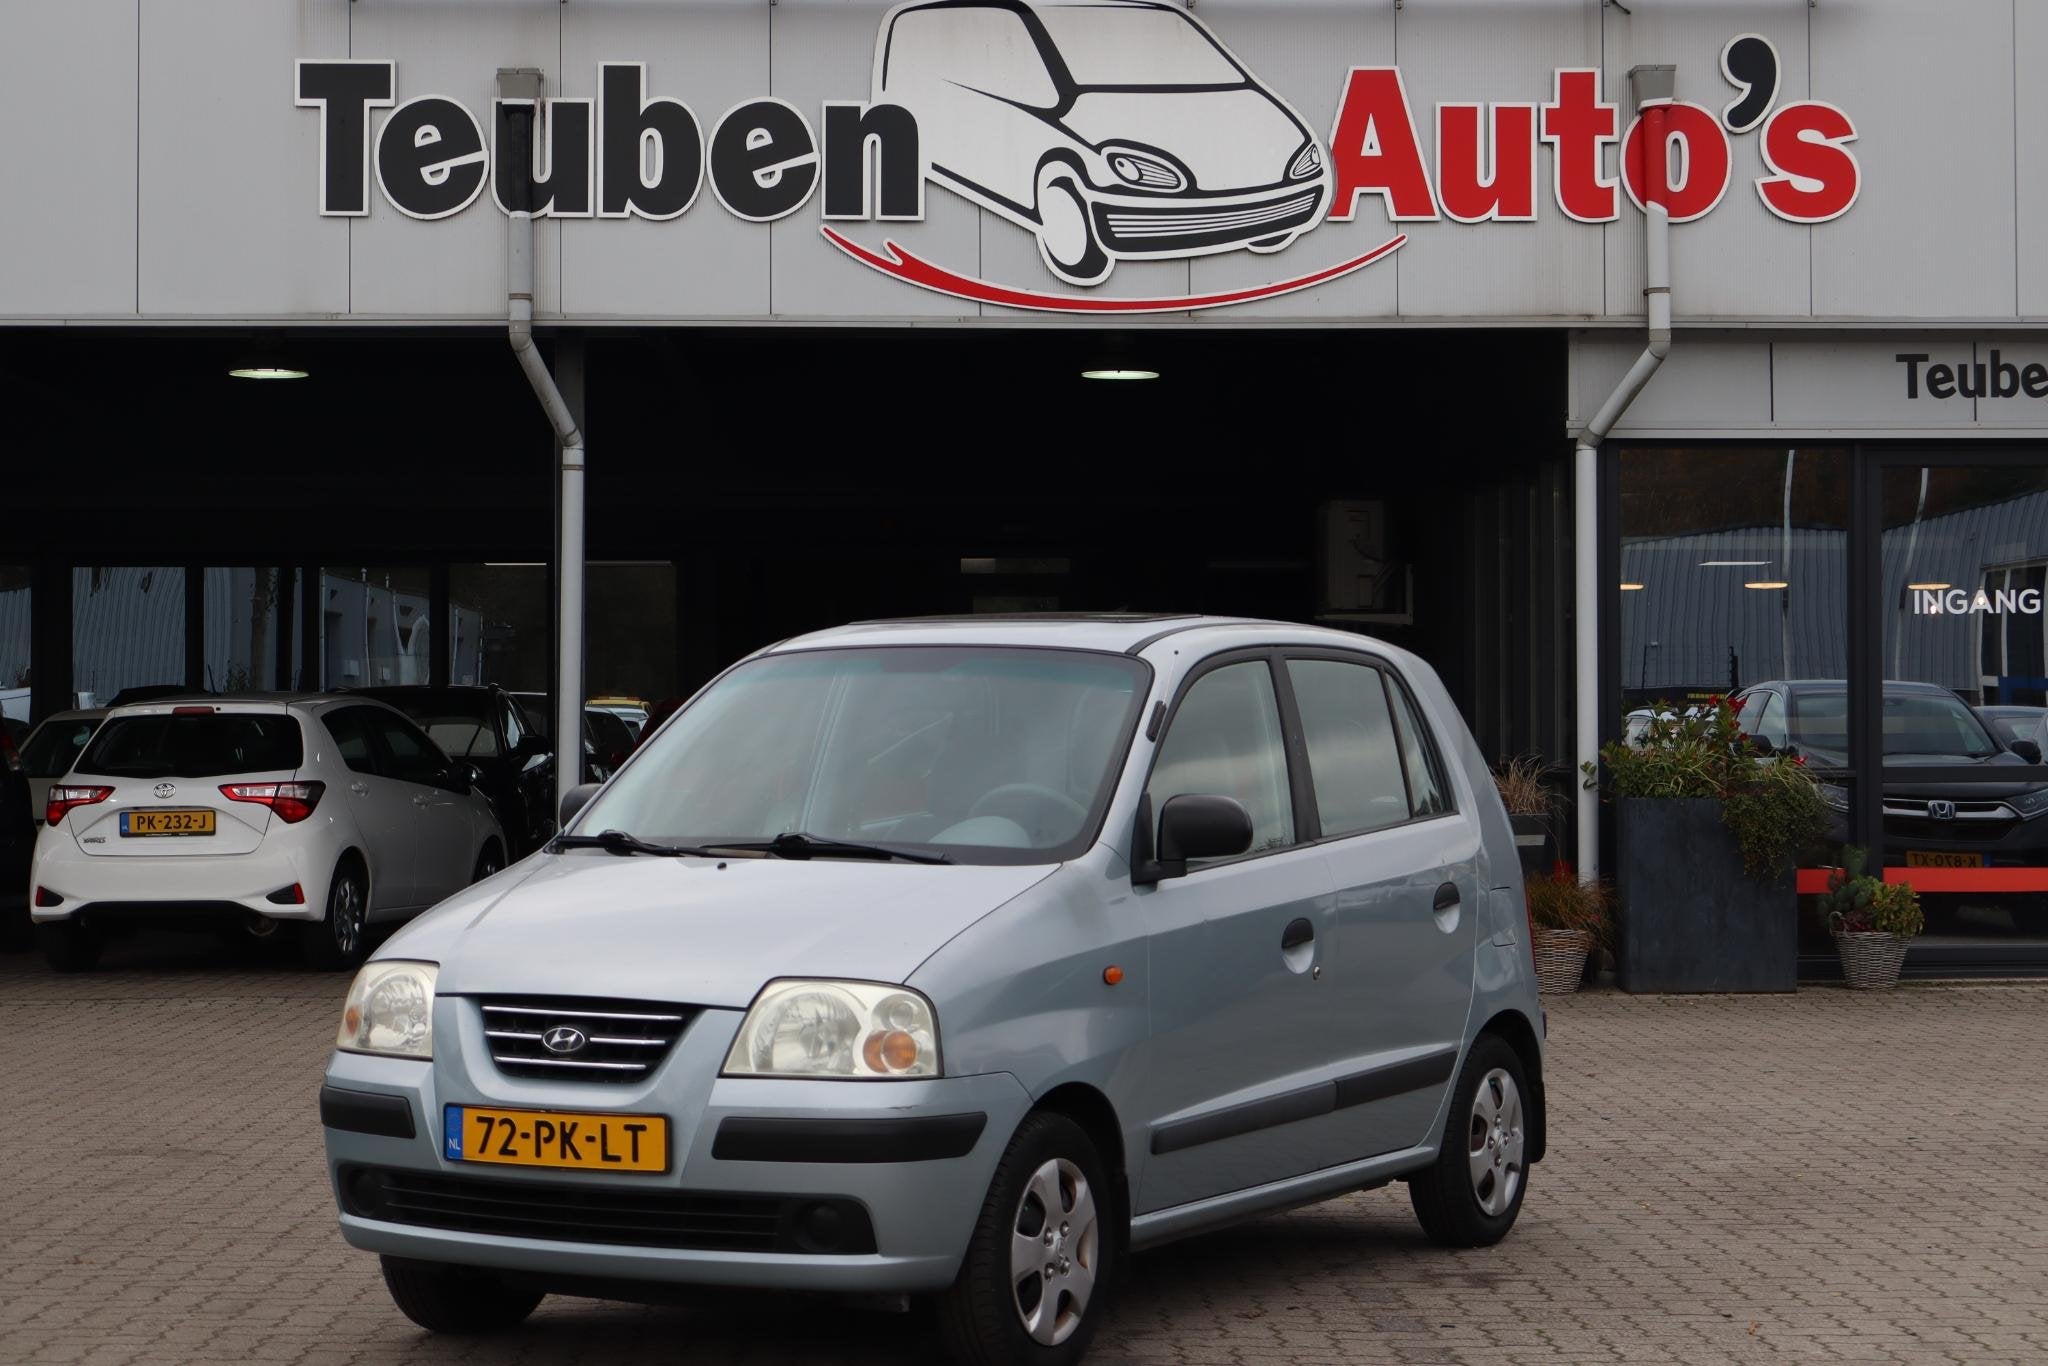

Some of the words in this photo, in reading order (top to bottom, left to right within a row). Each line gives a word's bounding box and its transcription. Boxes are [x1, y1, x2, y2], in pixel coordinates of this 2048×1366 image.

[297, 60, 923, 221] Teuben
[1328, 34, 1861, 223] Auto's
[1896, 350, 2048, 399] Teube
[1913, 588, 2041, 615] INGANG
[136, 815, 206, 831] PK-232-J
[448, 1137, 461, 1151] NL
[476, 1115, 647, 1163] 72-PK-LT
